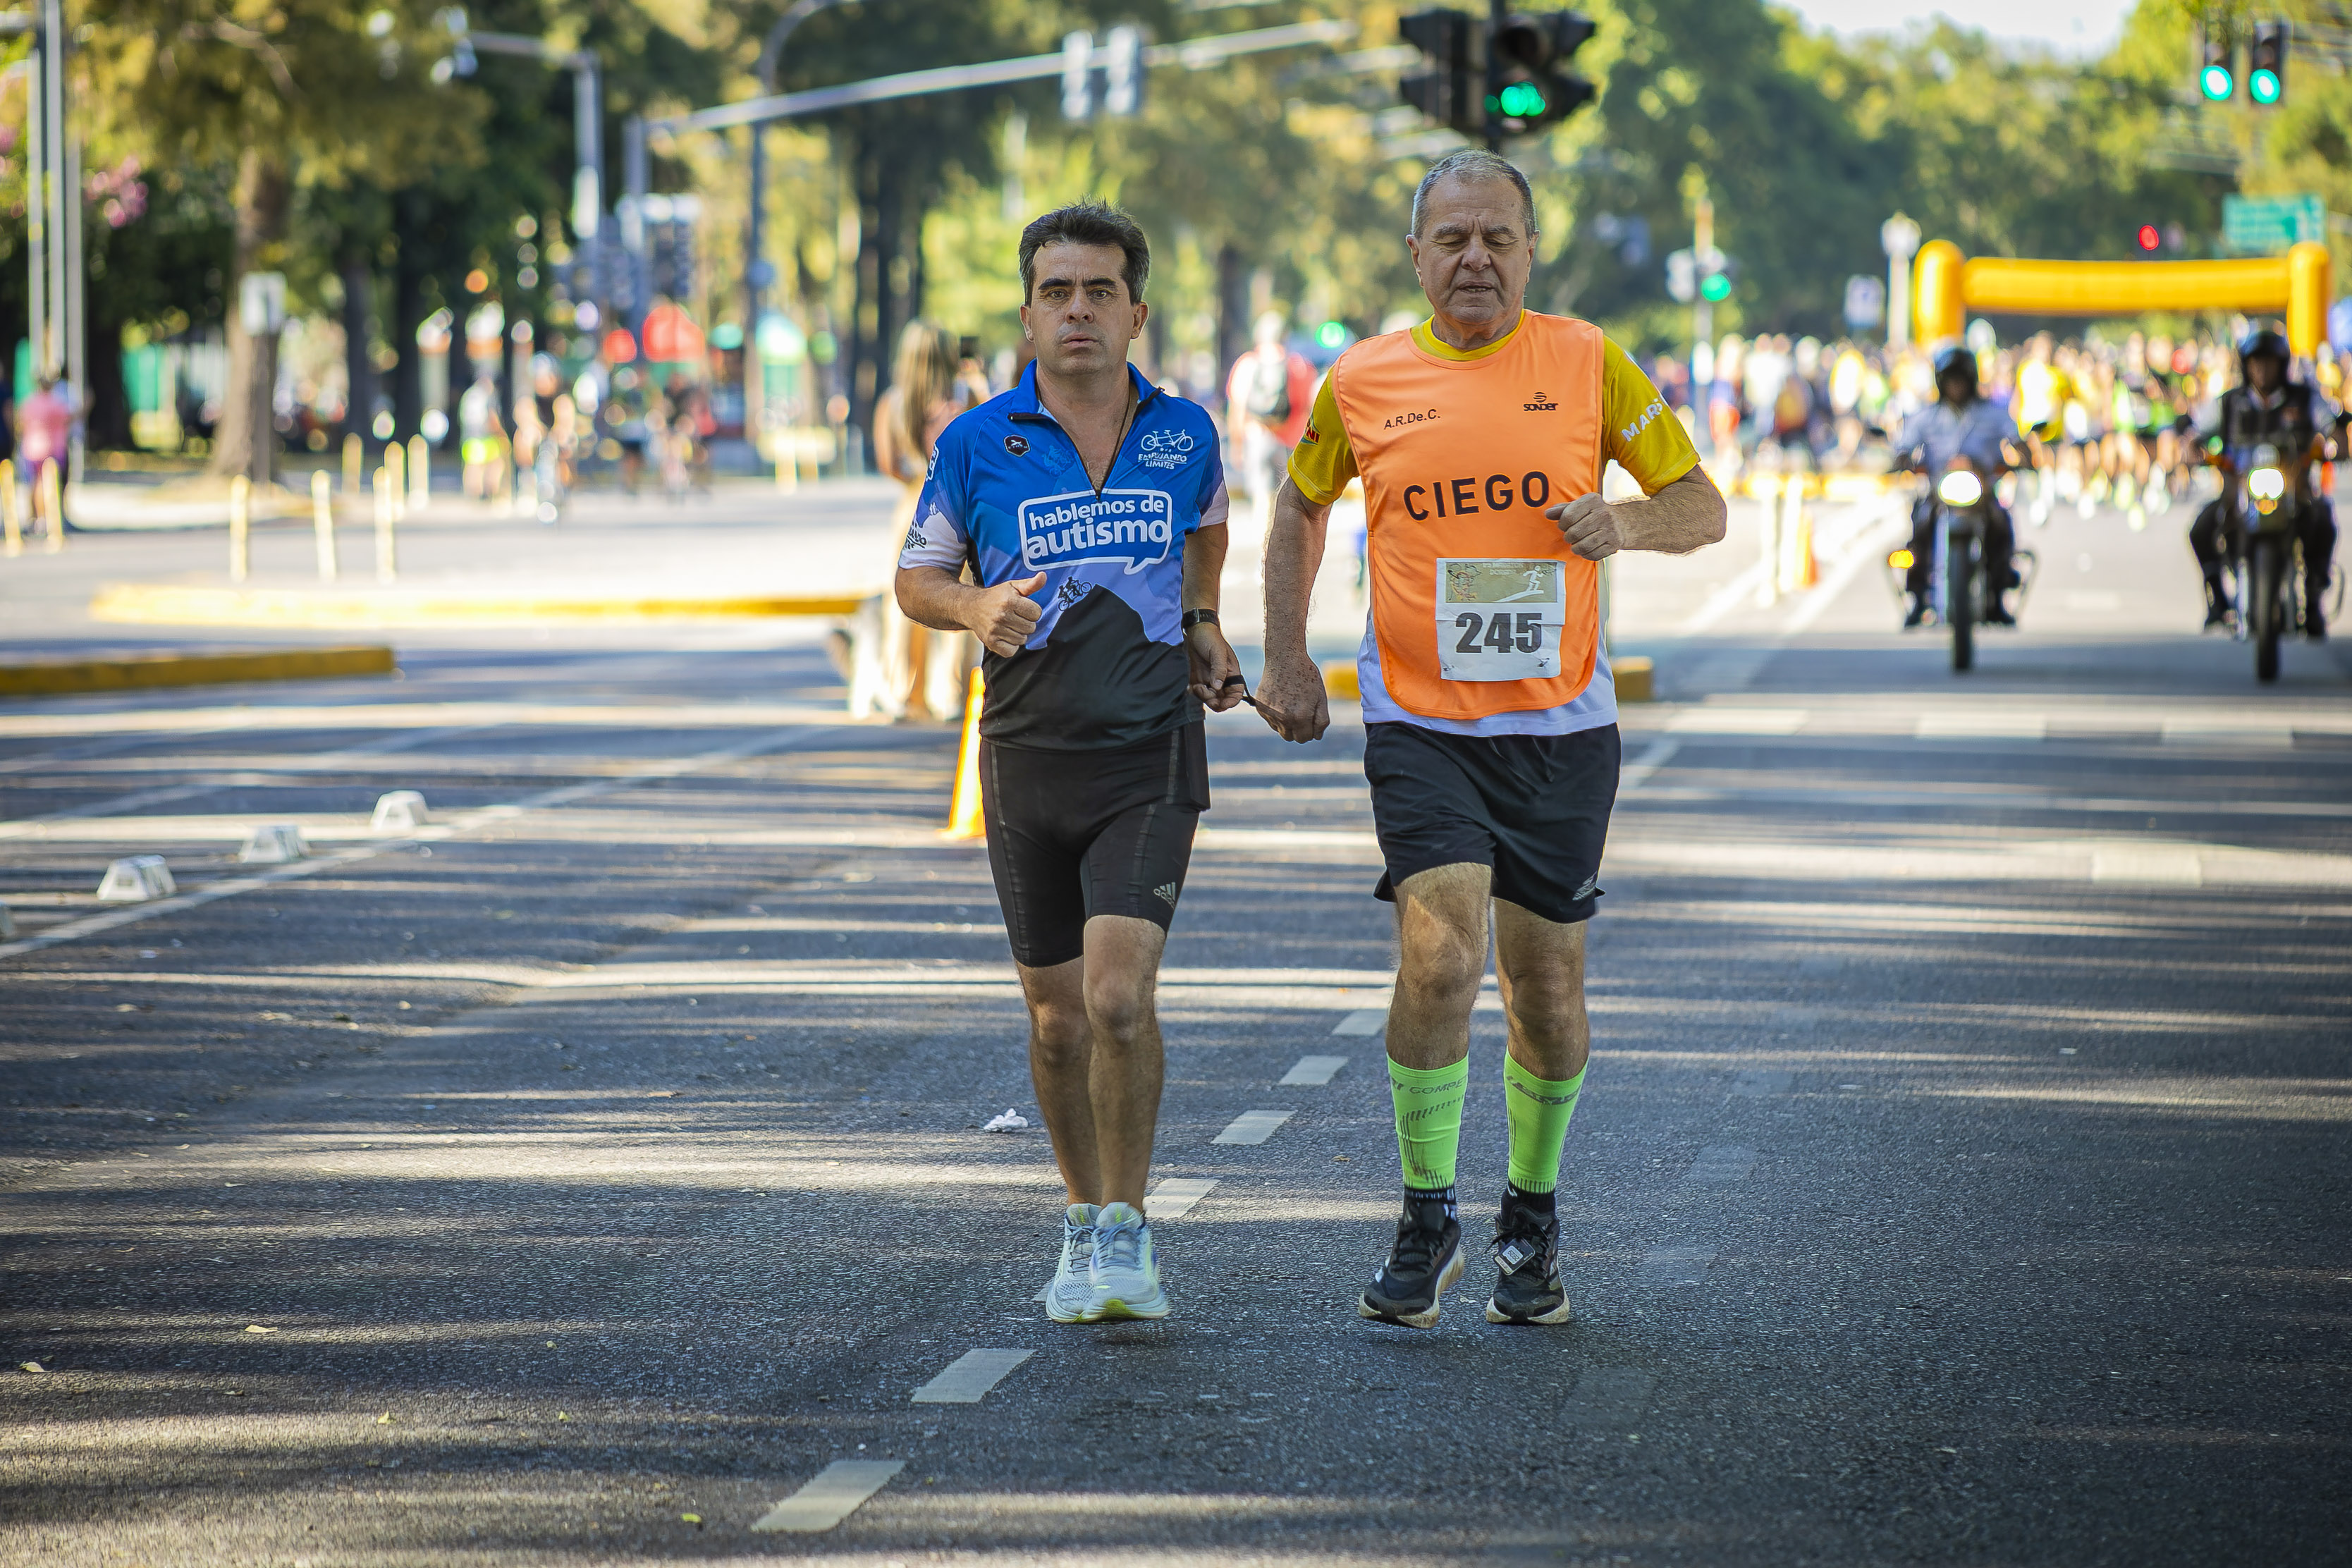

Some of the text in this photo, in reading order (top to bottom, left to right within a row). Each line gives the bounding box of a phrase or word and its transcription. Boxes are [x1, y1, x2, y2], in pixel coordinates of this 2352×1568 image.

[1383, 408, 1441, 430] A.R.De.C.
[1029, 494, 1165, 530] hablemos de
[1403, 471, 1550, 522] CIEGO
[1027, 517, 1168, 560] autismo
[1455, 612, 1543, 654] 245
